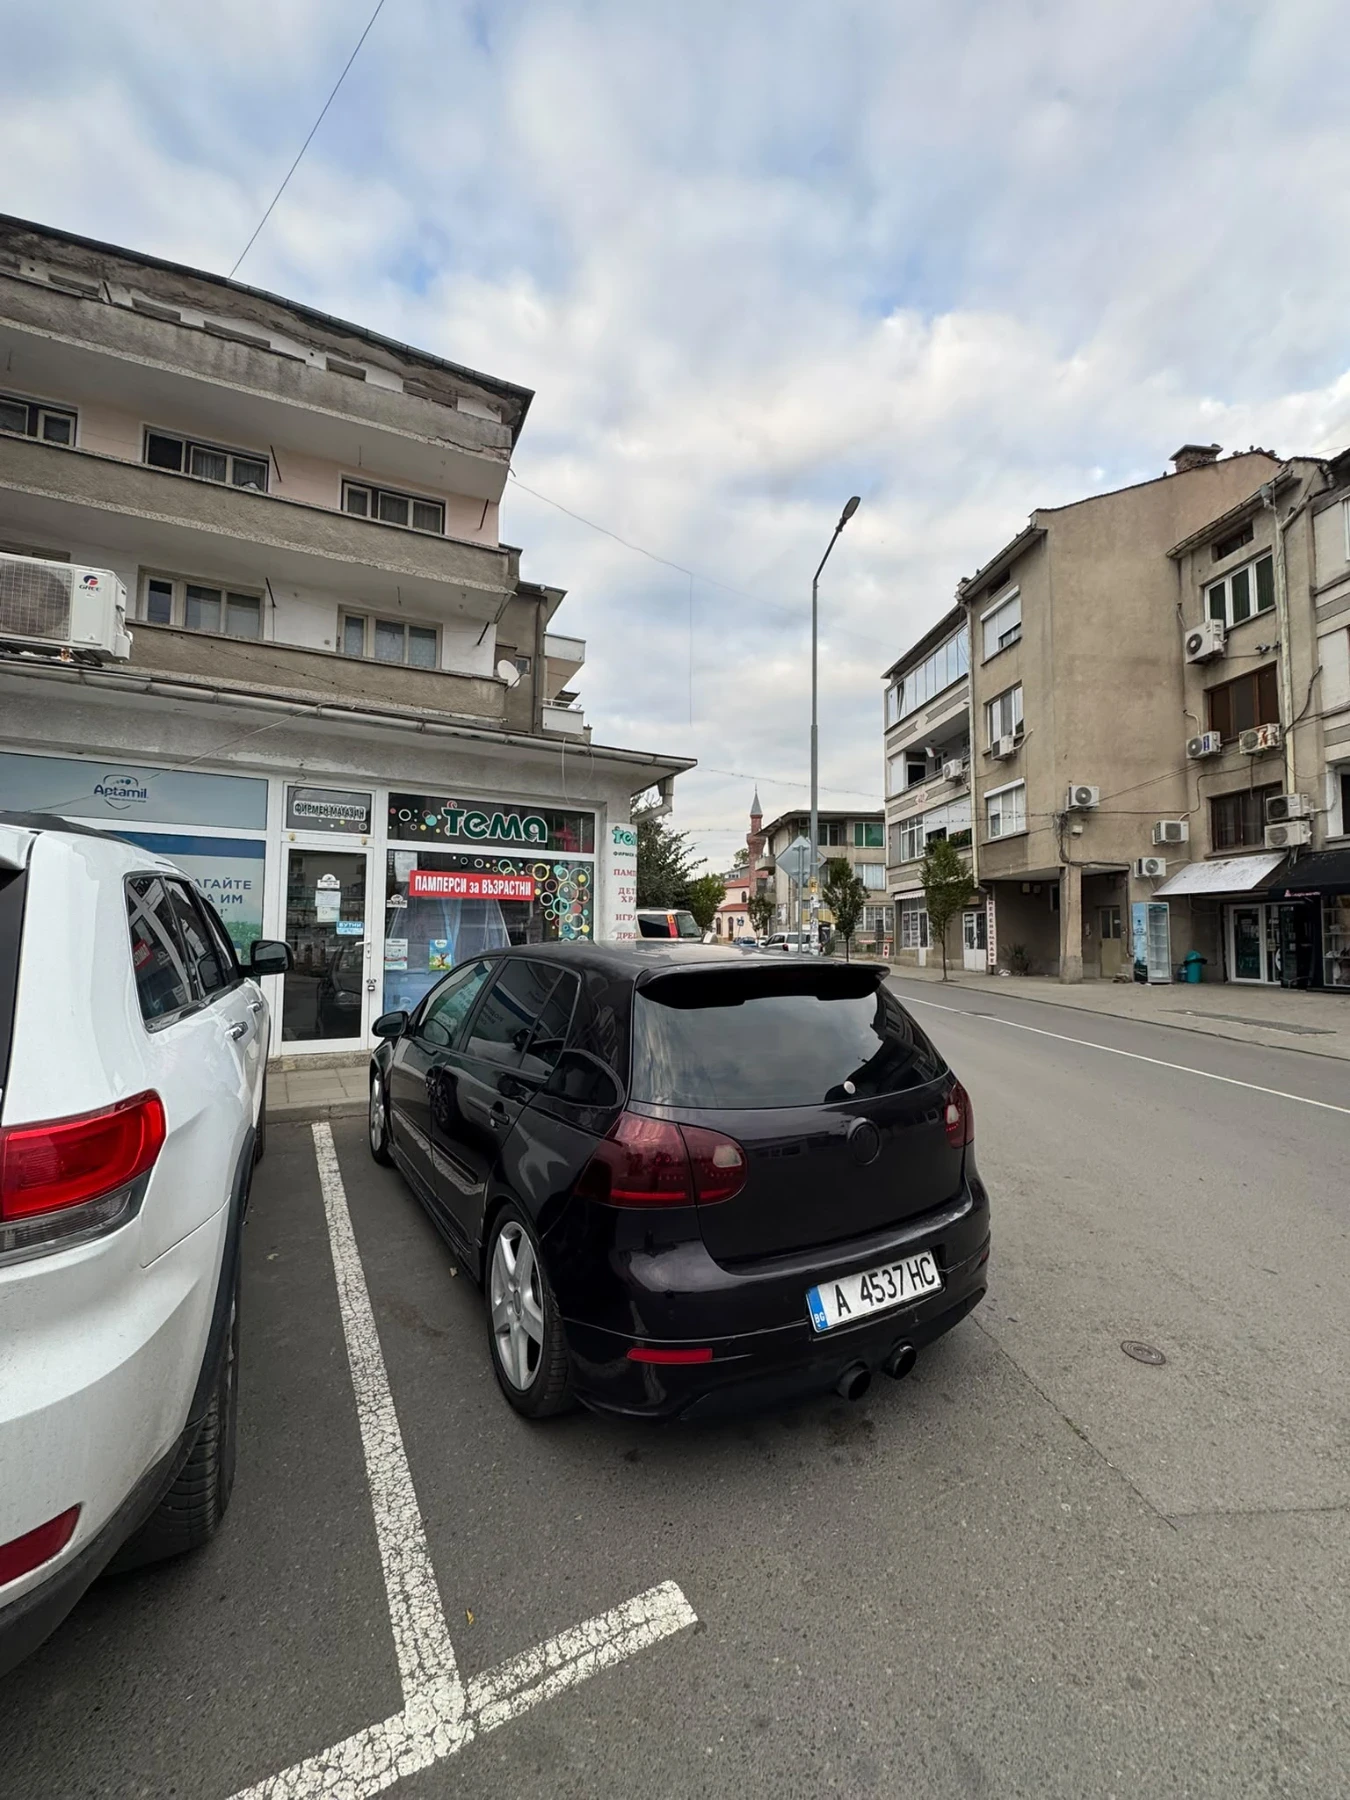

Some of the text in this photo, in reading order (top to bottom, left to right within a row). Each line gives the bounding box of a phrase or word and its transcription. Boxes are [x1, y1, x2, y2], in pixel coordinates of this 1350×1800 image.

[94, 784, 147, 798] Aptamil
[415, 875, 531, 896] ПАМПЕРСИ за ВЪЗРАСТНИ
[220, 894, 243, 904] ИМ
[835, 1256, 935, 1317] A 4537 HC
[813, 1312, 825, 1323] BG
